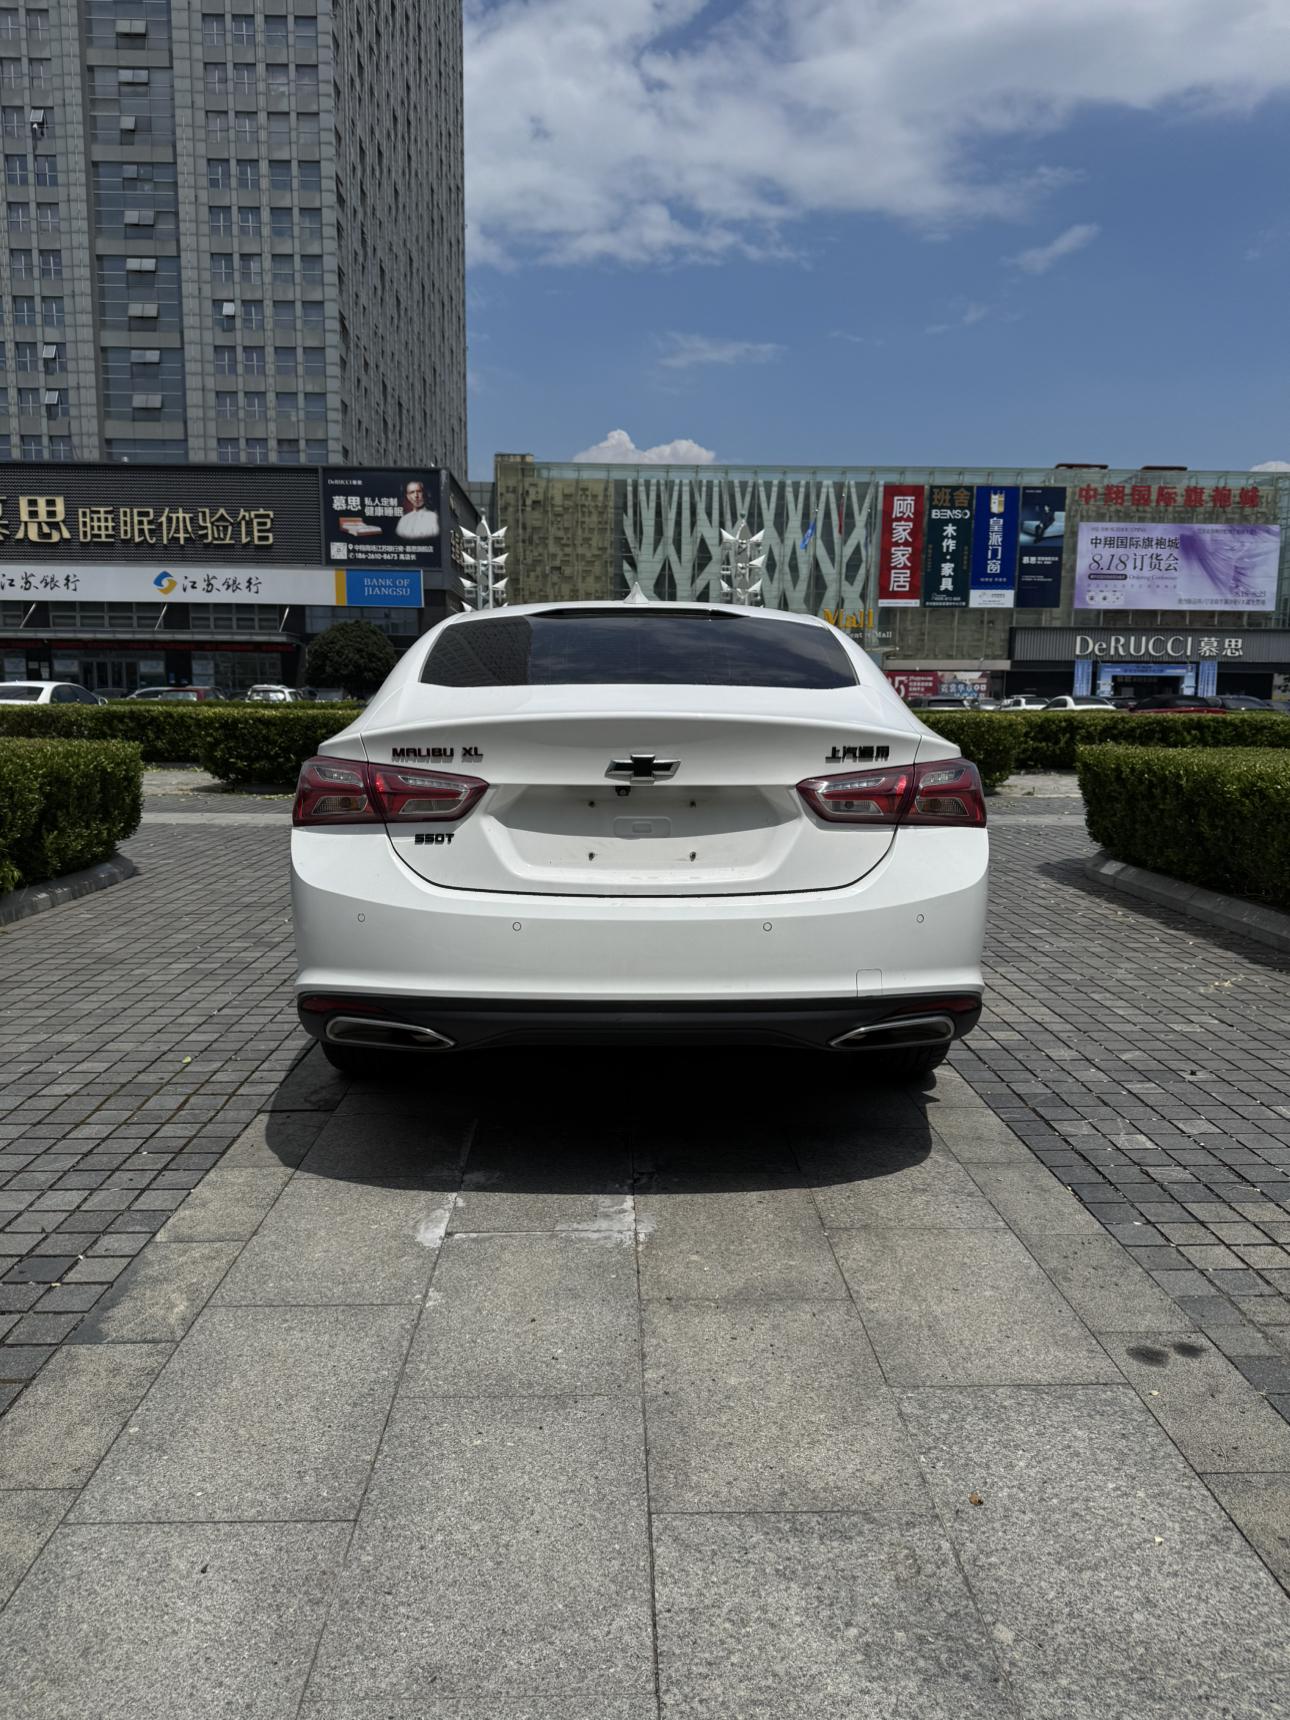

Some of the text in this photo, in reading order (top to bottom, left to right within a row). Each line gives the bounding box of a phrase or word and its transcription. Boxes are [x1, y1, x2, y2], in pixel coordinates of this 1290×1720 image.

[364, 497, 398, 507] 私人定制
[1078, 483, 1260, 508] 中翔国际旗袍城
[332, 496, 361, 511] 慕思
[0, 496, 274, 545] 思 睡眠体验馆
[931, 509, 970, 519] BENSO
[889, 496, 916, 592] 顾家家居
[987, 517, 1003, 574] 皇派门窗
[1090, 536, 1180, 549] 中翔国际旗袍城
[0, 572, 81, 592] 江苏银行
[182, 573, 262, 595] 江苏银行
[364, 578, 410, 587] BANK OF
[364, 588, 410, 596] JIANGSU
[1075, 636, 1243, 657] DeRUCCI 慕思
[392, 746, 483, 759] MALIBU XL
[414, 833, 455, 844] 550T
